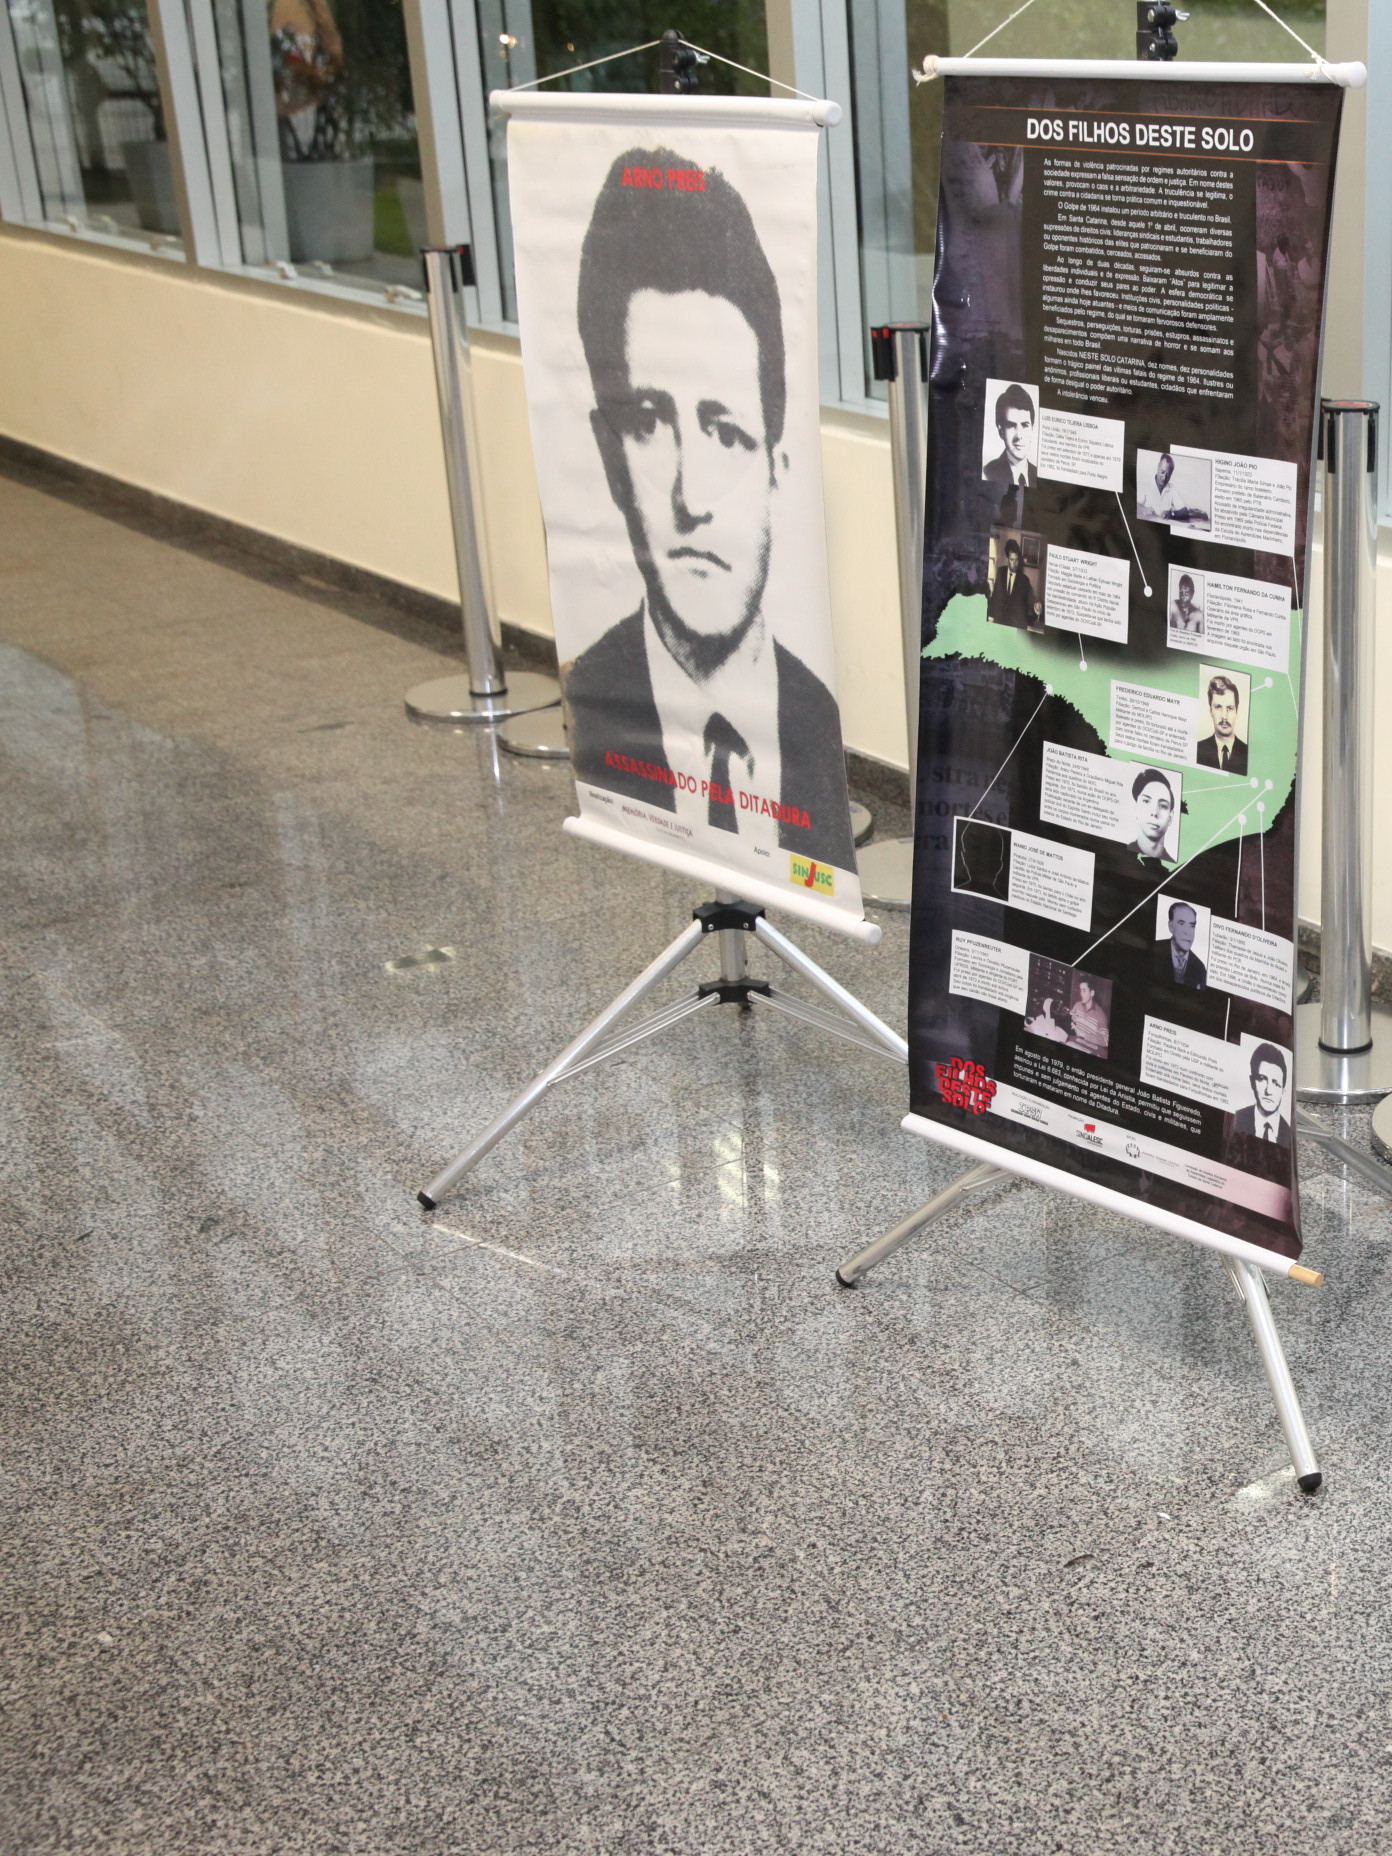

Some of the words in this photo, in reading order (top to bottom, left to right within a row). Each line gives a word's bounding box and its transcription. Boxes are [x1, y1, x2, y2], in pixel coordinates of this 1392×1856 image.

[1026, 117, 1063, 140] DOS
[1068, 119, 1130, 144] FILHOS
[1135, 123, 1195, 148] DESTE
[1201, 126, 1253, 151] SOLO
[1043, 157, 1051, 165] As
[1053, 158, 1071, 167] formas
[1073, 160, 1080, 168] de
[1082, 160, 1104, 169] violência
[1106, 162, 1138, 172] patrocinadas
[1140, 165, 1150, 173] por
[1152, 166, 1173, 175] regimes
[1176, 167, 1207, 177] autoritários
[1209, 169, 1227, 178] contra
[604, 750, 696, 793] ASSASSINADO
[701, 779, 735, 806] PELA
[739, 791, 811, 829] DITADURA
[951, 1056, 986, 1077] DOS
[1015, 1044, 1023, 1053] Em
[1024, 1049, 1041, 1061] agosto
[1041, 1055, 1049, 1063] de
[1050, 1058, 1064, 1069] 1979,
[1070, 1066, 1085, 1076] então
[1086, 1071, 1113, 1087] presidente
[1115, 1081, 1135, 1094] general
[1136, 1088, 1150, 1099] João
[1151, 1093, 1170, 1106] Batista
[1172, 1100, 1201, 1118] Figueiredo,
[942, 1089, 986, 1115] SOLO
